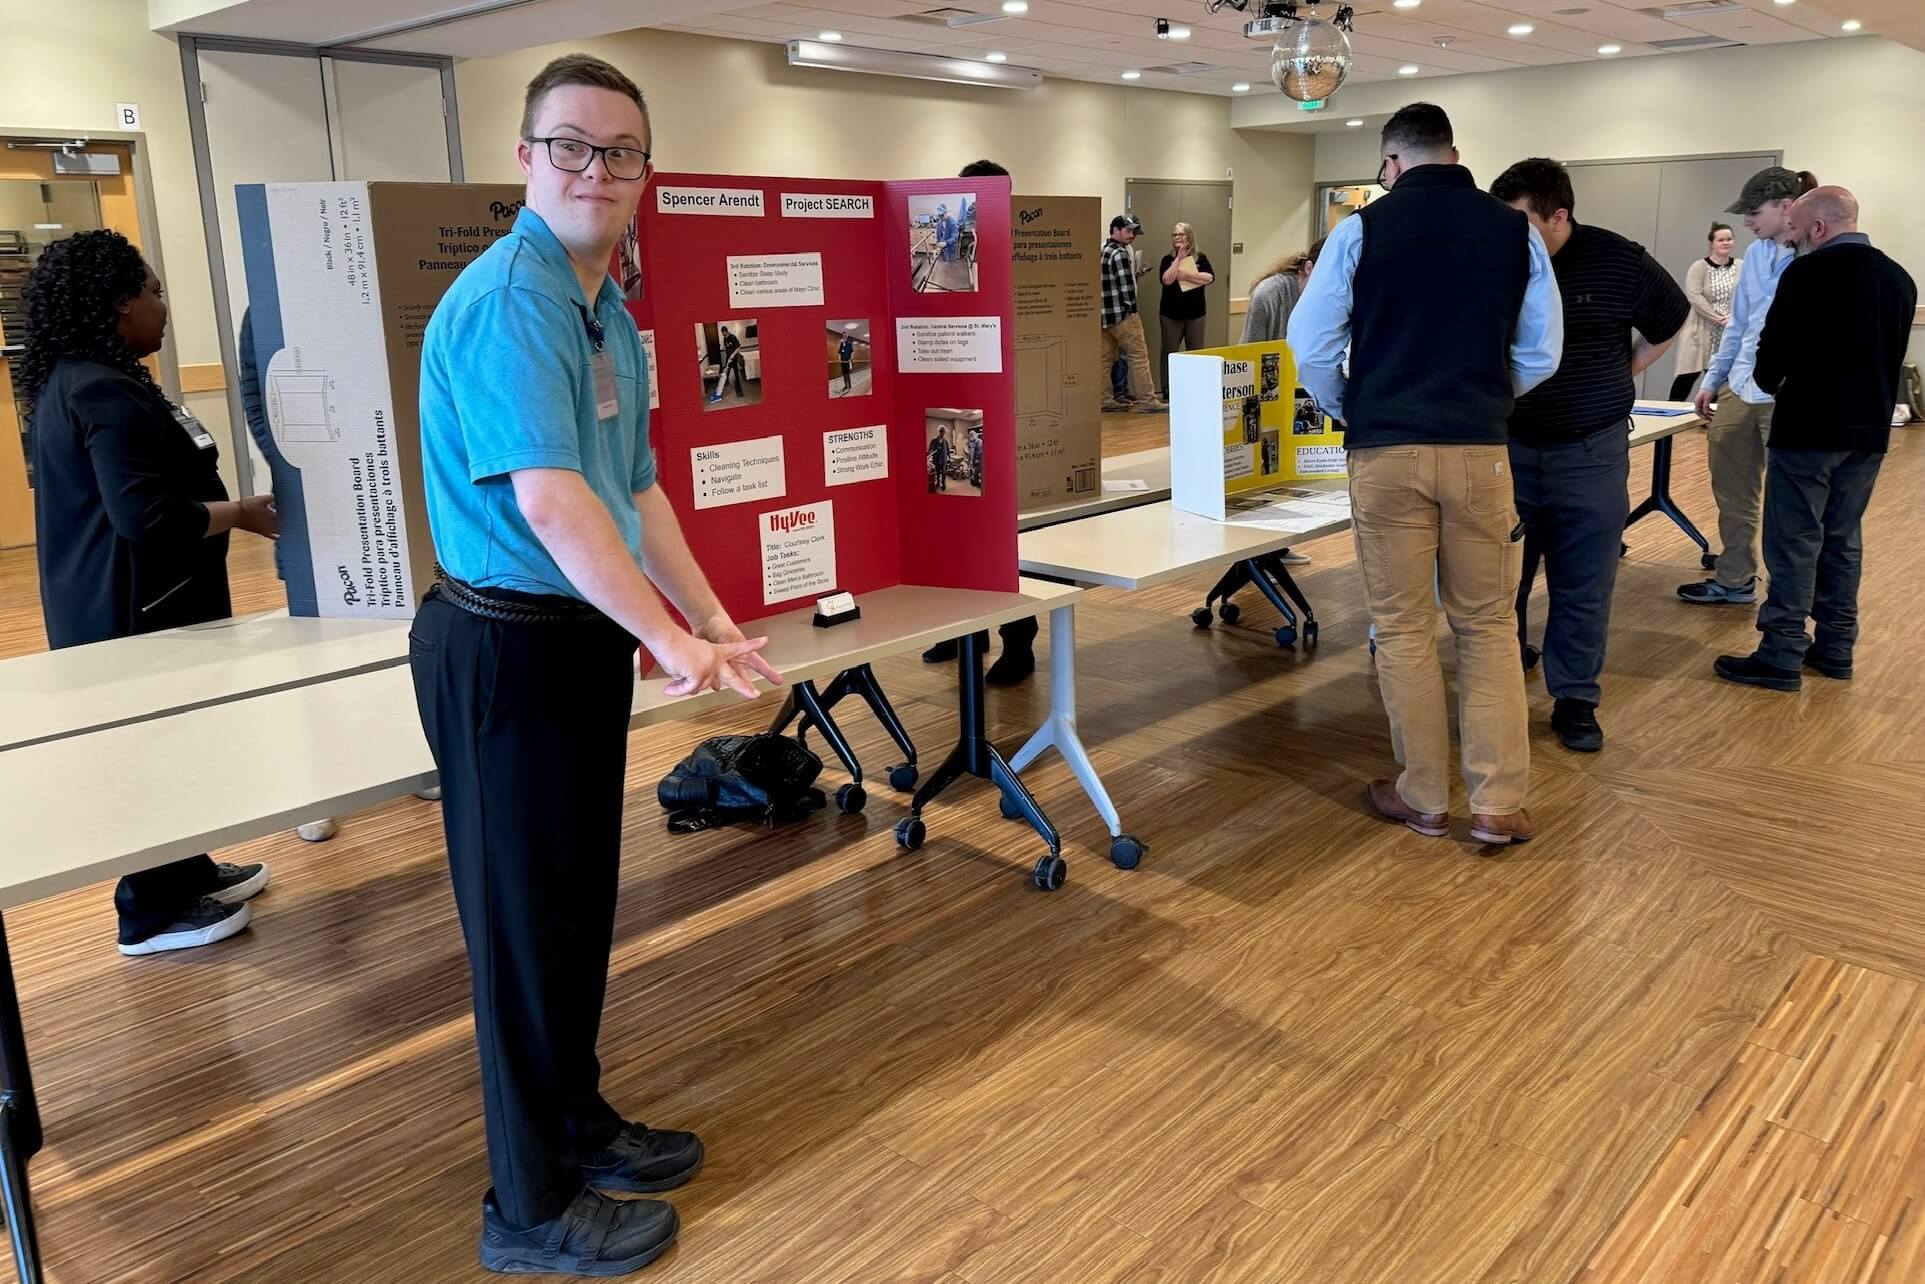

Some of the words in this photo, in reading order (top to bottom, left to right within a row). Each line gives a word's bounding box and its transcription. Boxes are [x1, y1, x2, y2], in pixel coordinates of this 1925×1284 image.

[123, 108, 135, 124] B
[662, 192, 715, 208] Spencer
[719, 193, 760, 207] Arendt
[786, 198, 823, 212] Project
[826, 198, 869, 210] SEARCH
[489, 199, 526, 221] Paco
[1019, 208, 1043, 225] Pacon
[439, 226, 480, 238] Tri-Fold
[1014, 229, 1051, 238] Presentation
[1052, 228, 1071, 237] Board
[346, 273, 356, 286] 48
[1223, 361, 1248, 375] hase
[1222, 384, 1255, 400] terson
[374, 410, 388, 456] battants
[828, 430, 874, 444] STRENGTHS
[696, 450, 720, 461] Skills
[835, 443, 876, 454] Communication
[1297, 446, 1345, 455] EDUCATIO
[709, 461, 740, 472] Cleaning
[742, 454, 780, 467] Techniques
[836, 455, 857, 464] Positive
[858, 452, 879, 461] Attitude
[349, 458, 363, 491] Board
[379, 459, 391, 486] trois
[837, 465, 855, 474] Strong
[855, 462, 869, 471] Work
[711, 472, 742, 485] Navigate
[365, 452, 386, 536] presentaciones
[712, 486, 734, 497] Follow
[742, 481, 757, 491] task
[758, 479, 769, 489] list
[356, 494, 372, 564] Presentation
[385, 498, 400, 558] d'affichage
[376, 539, 389, 564] para
[766, 543, 781, 551] Title:
[784, 538, 810, 548] Courtesy
[780, 551, 800, 559] Tasks:
[338, 565, 361, 606] Pacon
[362, 567, 377, 607] Tri-Fold
[391, 561, 405, 607] Panneau
